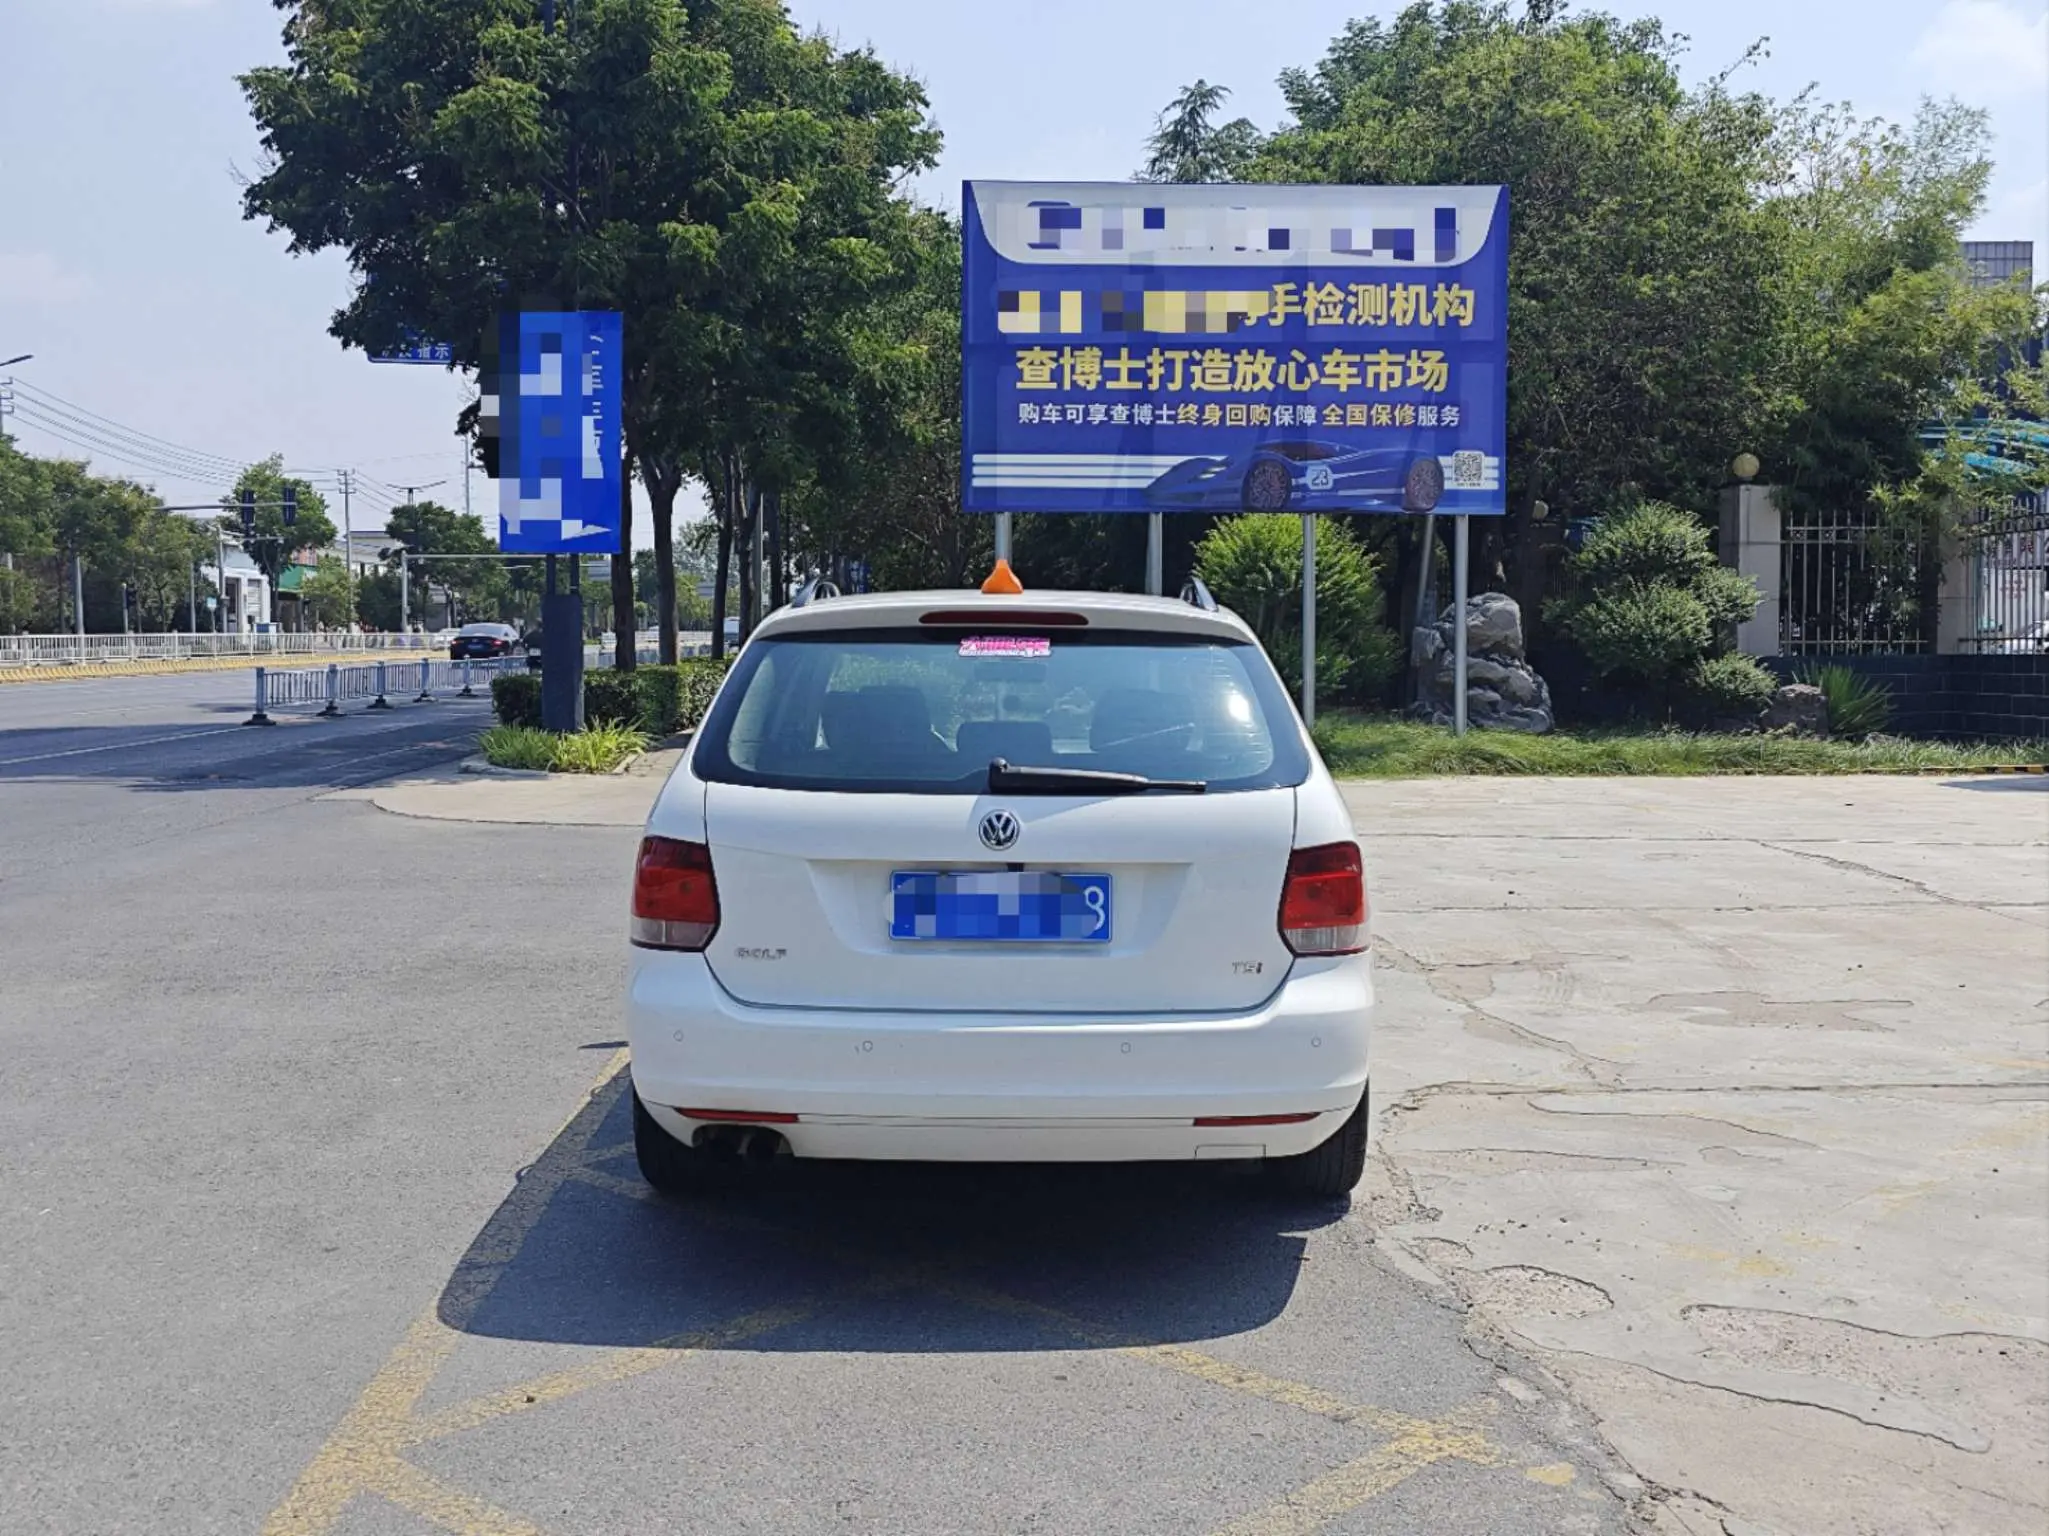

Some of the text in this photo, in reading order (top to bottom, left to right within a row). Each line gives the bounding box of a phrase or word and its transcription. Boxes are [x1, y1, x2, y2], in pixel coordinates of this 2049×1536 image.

[1240, 282, 1475, 326] 手检测机构
[1016, 346, 1449, 392] 查博士打造放心车市场
[1018, 403, 1460, 427] 购车可享查博士终身回购保障 全国保修服务
[1311, 468, 1329, 486] 23
